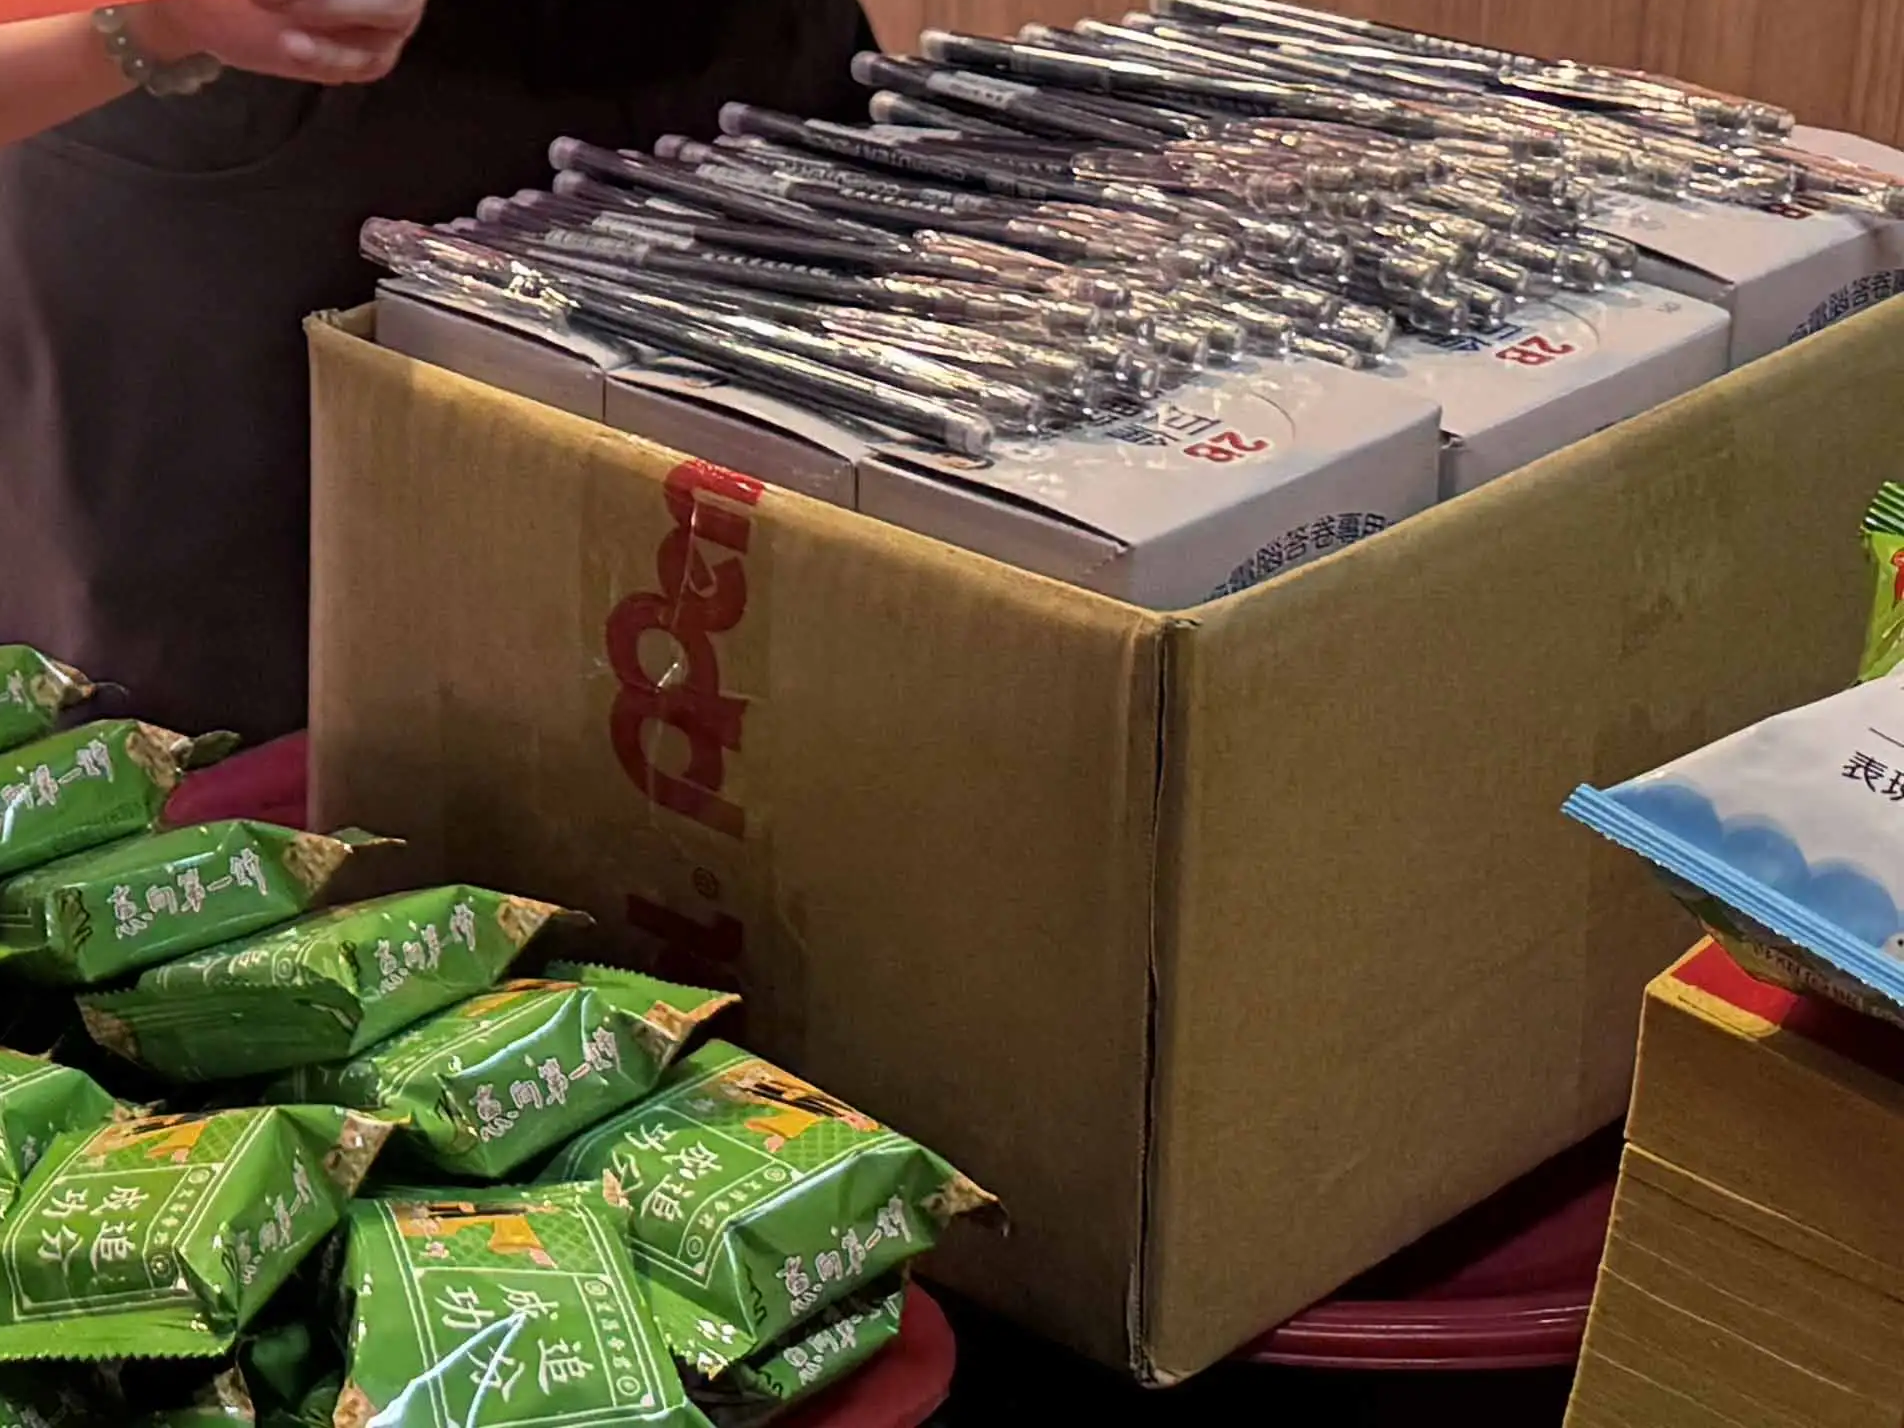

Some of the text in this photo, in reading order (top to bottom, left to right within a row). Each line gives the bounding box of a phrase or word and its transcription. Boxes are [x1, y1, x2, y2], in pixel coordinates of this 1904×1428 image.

[1496, 334, 1575, 367] 2B
[1183, 430, 1271, 464] 2B
[50, 1183, 150, 1219] 成功
[37, 1218, 138, 1273] 追分
[436, 1284, 560, 1331] 成功
[466, 1337, 597, 1402] 追分
